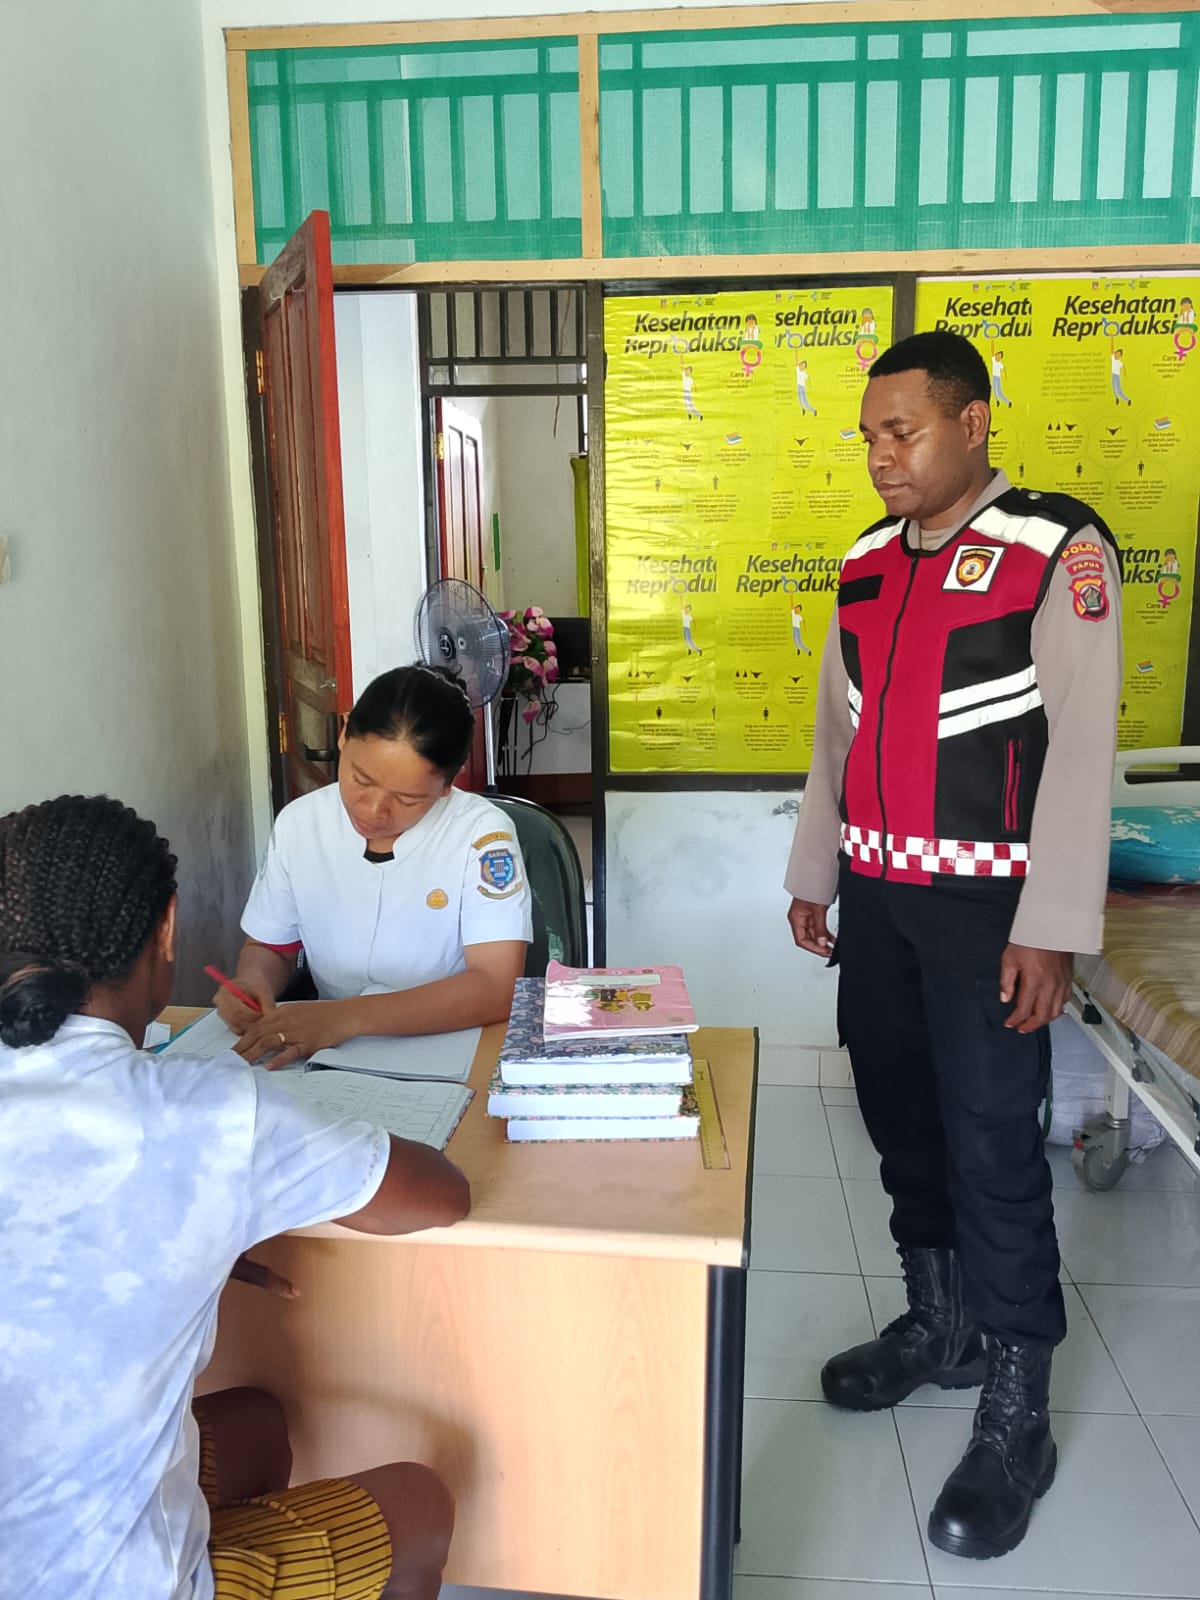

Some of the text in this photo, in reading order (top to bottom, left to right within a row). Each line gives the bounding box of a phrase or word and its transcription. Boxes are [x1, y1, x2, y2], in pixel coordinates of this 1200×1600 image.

[1063, 294, 1176, 316] Kesehatan
[634, 310, 742, 333] Kesehatan
[1052, 314, 1179, 341] Reproduksi
[774, 324, 860, 350] roduksi
[1061, 543, 1101, 560] POLDA
[1072, 561, 1100, 573] PAPUA
